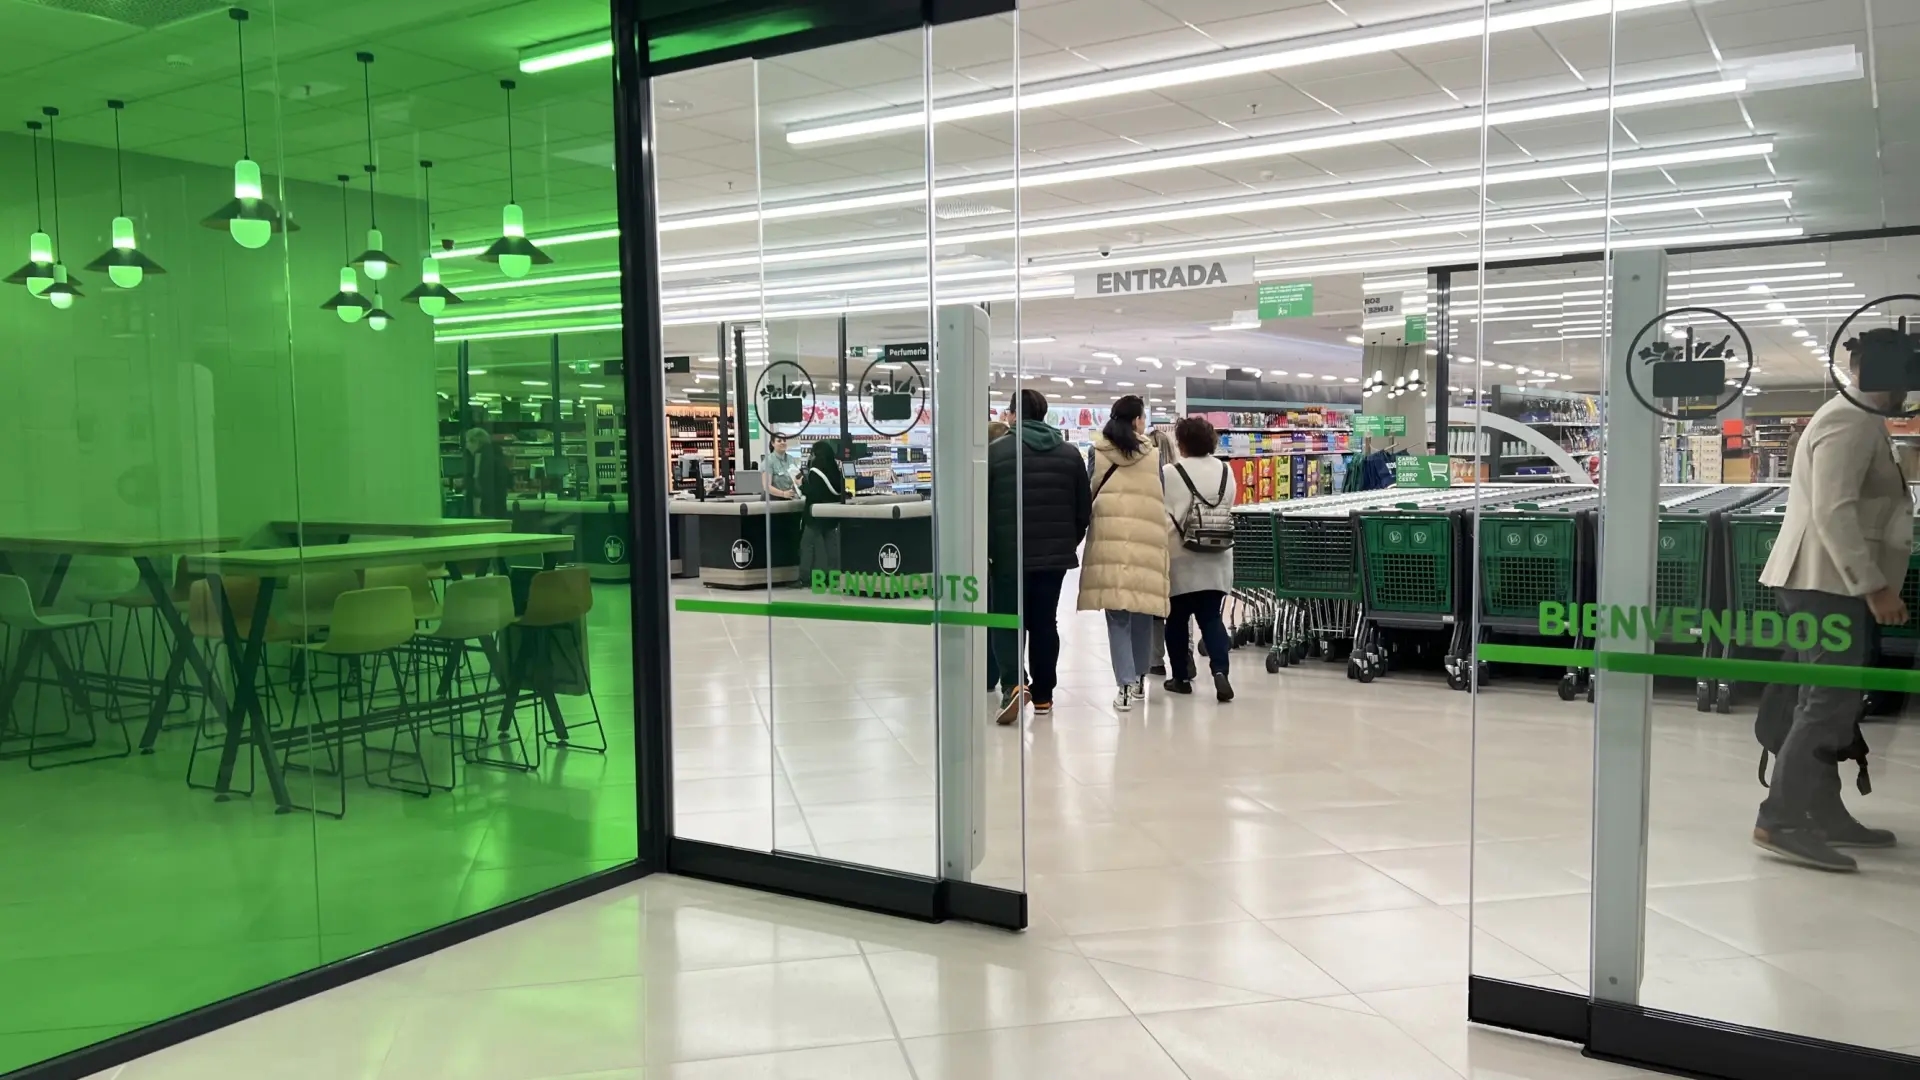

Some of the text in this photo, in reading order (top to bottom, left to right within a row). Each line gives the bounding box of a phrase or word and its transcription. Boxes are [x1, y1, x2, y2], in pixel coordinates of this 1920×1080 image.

[1096, 262, 1227, 294] ENTRADA
[811, 569, 979, 602] BENVINGUTS
[1538, 601, 1852, 652] BIENVENIDOS
